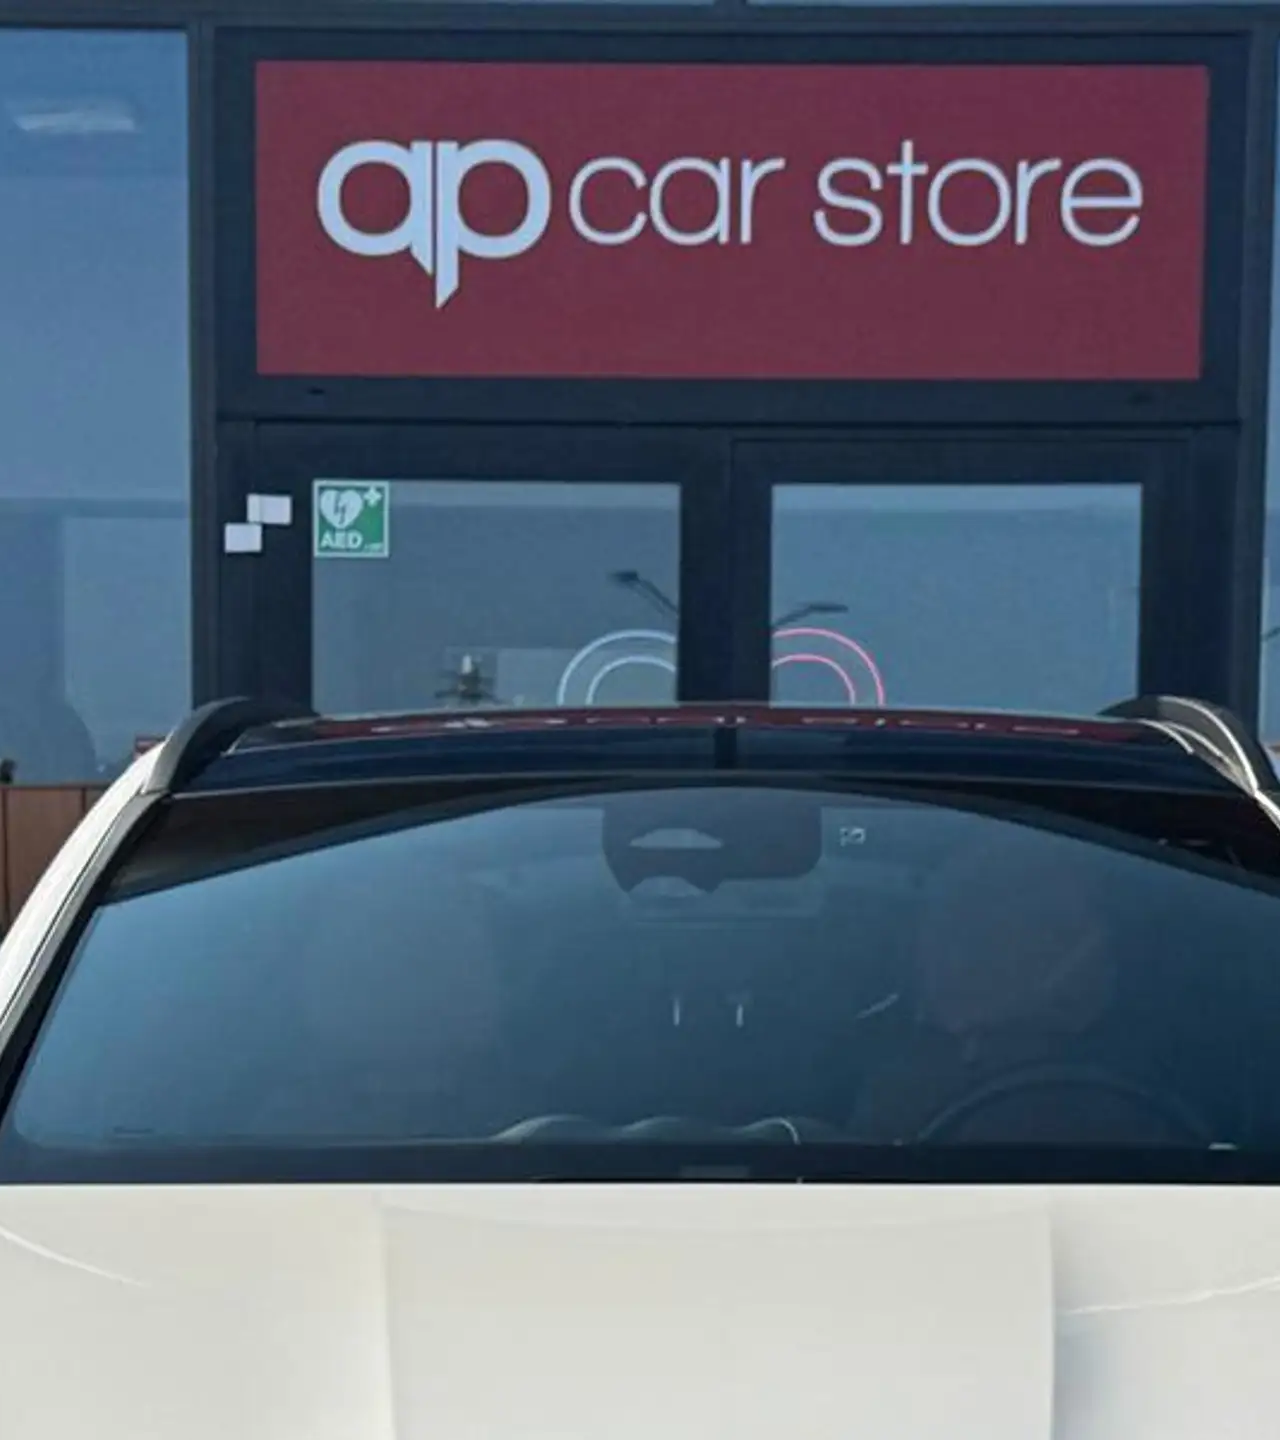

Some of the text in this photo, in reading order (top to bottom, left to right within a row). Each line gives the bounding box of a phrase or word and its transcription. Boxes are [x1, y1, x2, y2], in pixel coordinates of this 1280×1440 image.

[318, 139, 1143, 308] ap car store
[320, 529, 363, 549] AED
